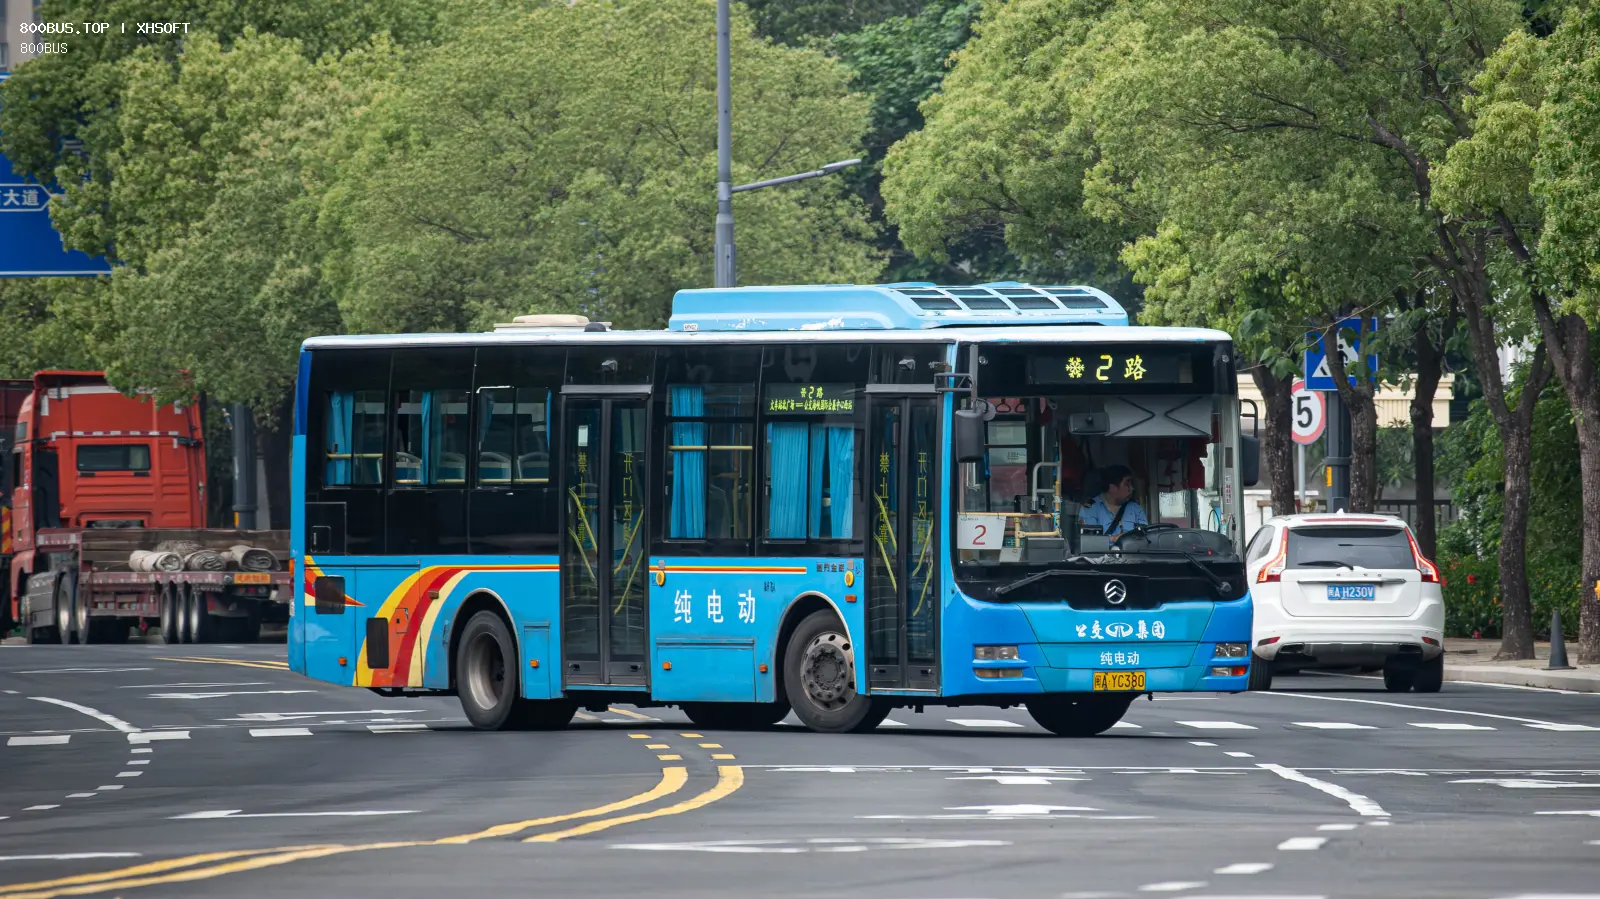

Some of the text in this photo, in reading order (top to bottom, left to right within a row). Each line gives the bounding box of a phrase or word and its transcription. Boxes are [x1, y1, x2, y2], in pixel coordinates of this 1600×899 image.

[0, 189, 39, 206] 大道
[1297, 396, 1313, 428] 5
[973, 525, 987, 545] 2
[674, 589, 756, 624] 纯电动
[1100, 651, 1140, 666] 纯电动
